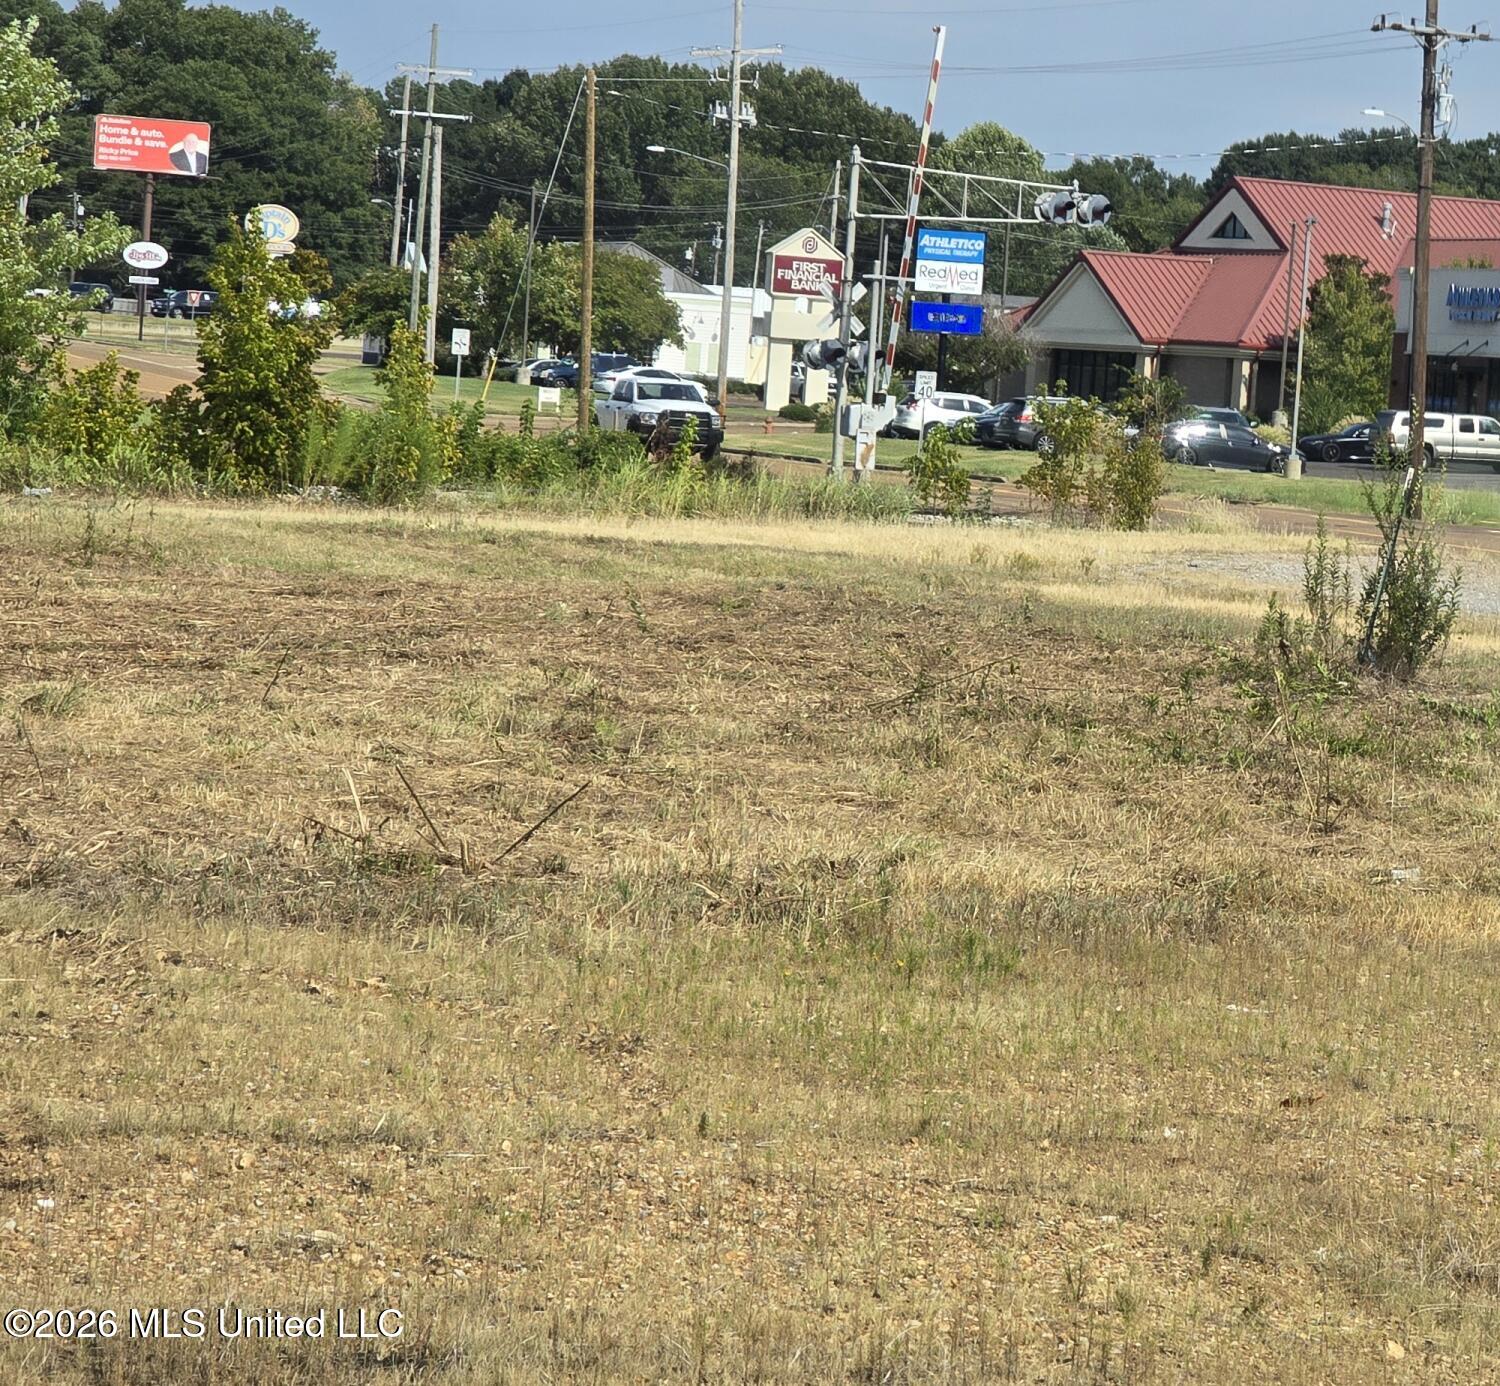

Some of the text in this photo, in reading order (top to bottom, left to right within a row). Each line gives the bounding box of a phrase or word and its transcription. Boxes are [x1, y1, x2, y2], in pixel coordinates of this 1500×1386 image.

[99, 124, 165, 138] Home & auto.
[98, 134, 169, 149] Bundle & save.
[919, 233, 985, 251] ATHLETICO
[792, 261, 827, 273] FIRST
[777, 268, 839, 284] FINANCIAL
[919, 264, 979, 288] RedMed
[917, 386, 933, 399] 40
